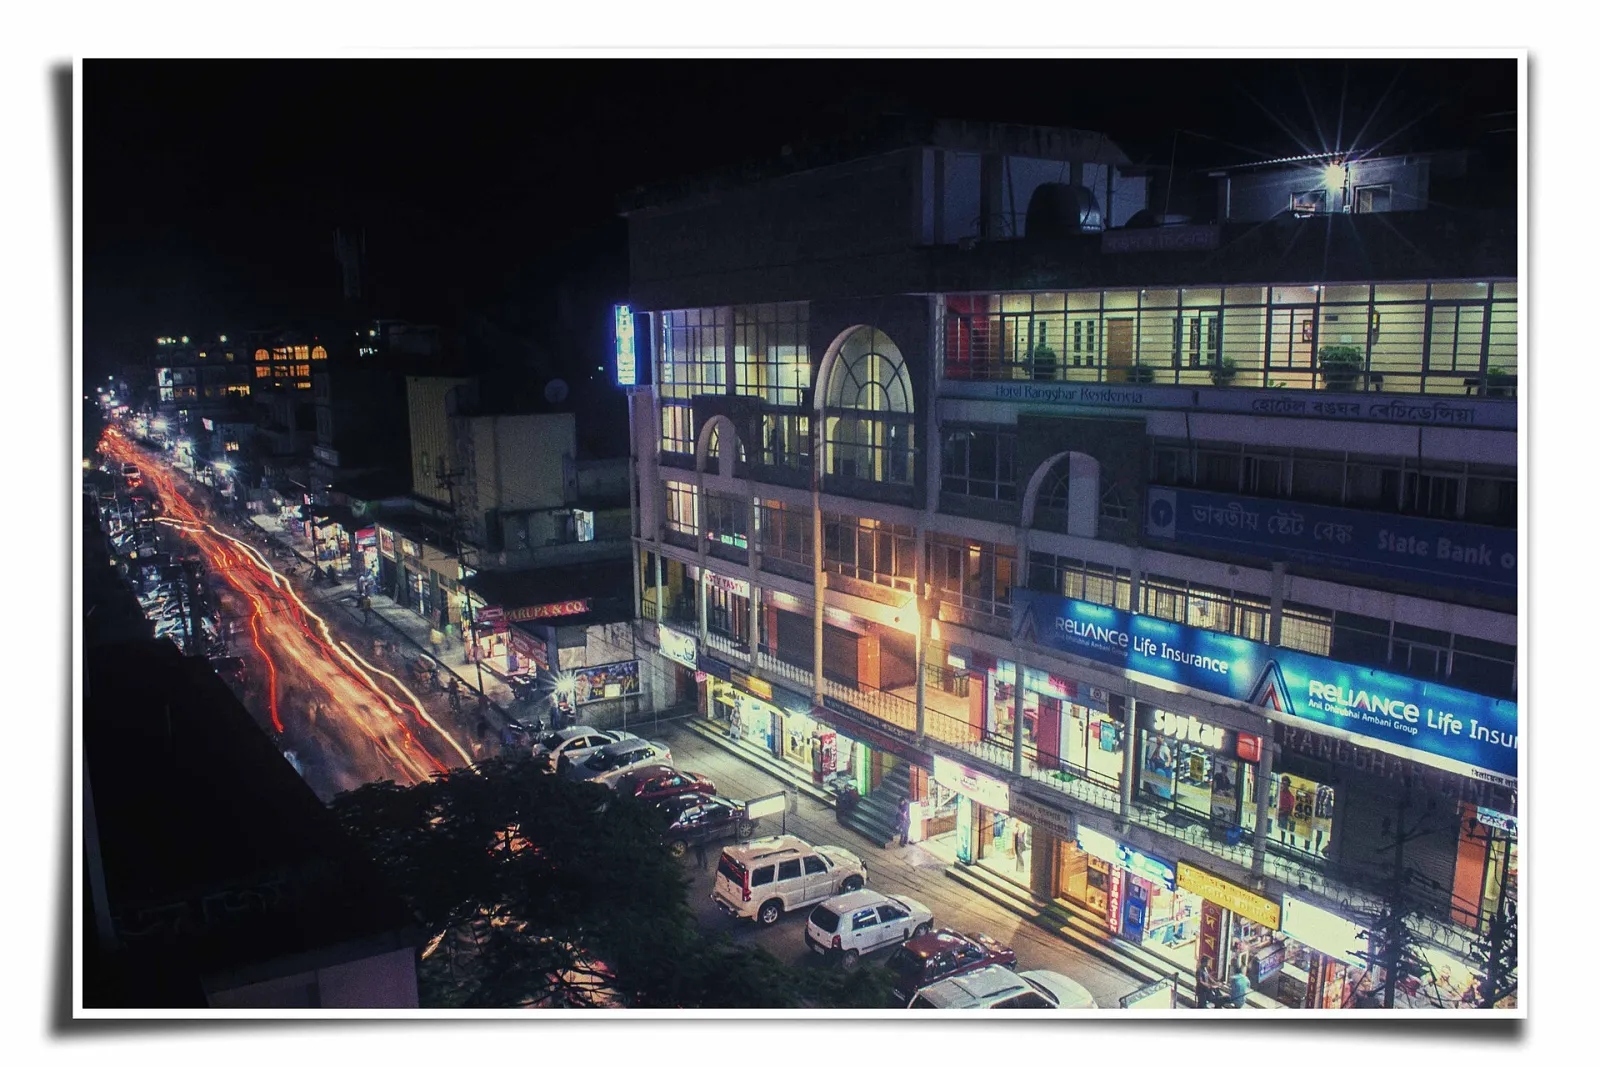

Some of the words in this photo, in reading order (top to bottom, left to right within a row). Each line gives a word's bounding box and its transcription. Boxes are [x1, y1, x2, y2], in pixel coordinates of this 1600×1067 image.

[996, 385, 1022, 398] Hotel
[1024, 386, 1078, 400] Rangghar
[1080, 388, 1143, 404] Residencia
[1378, 529, 1428, 557] State
[1437, 538, 1493, 567] Bank
[551, 604, 563, 616] &
[1134, 635, 1157, 658] Life
[1161, 643, 1229, 675] Insurance
[1308, 699, 1323, 710] Anil
[1325, 703, 1360, 720] Dhirubhai
[1362, 712, 1392, 728] Ambani
[1394, 719, 1418, 735] Group
[1427, 709, 1462, 736] Life
